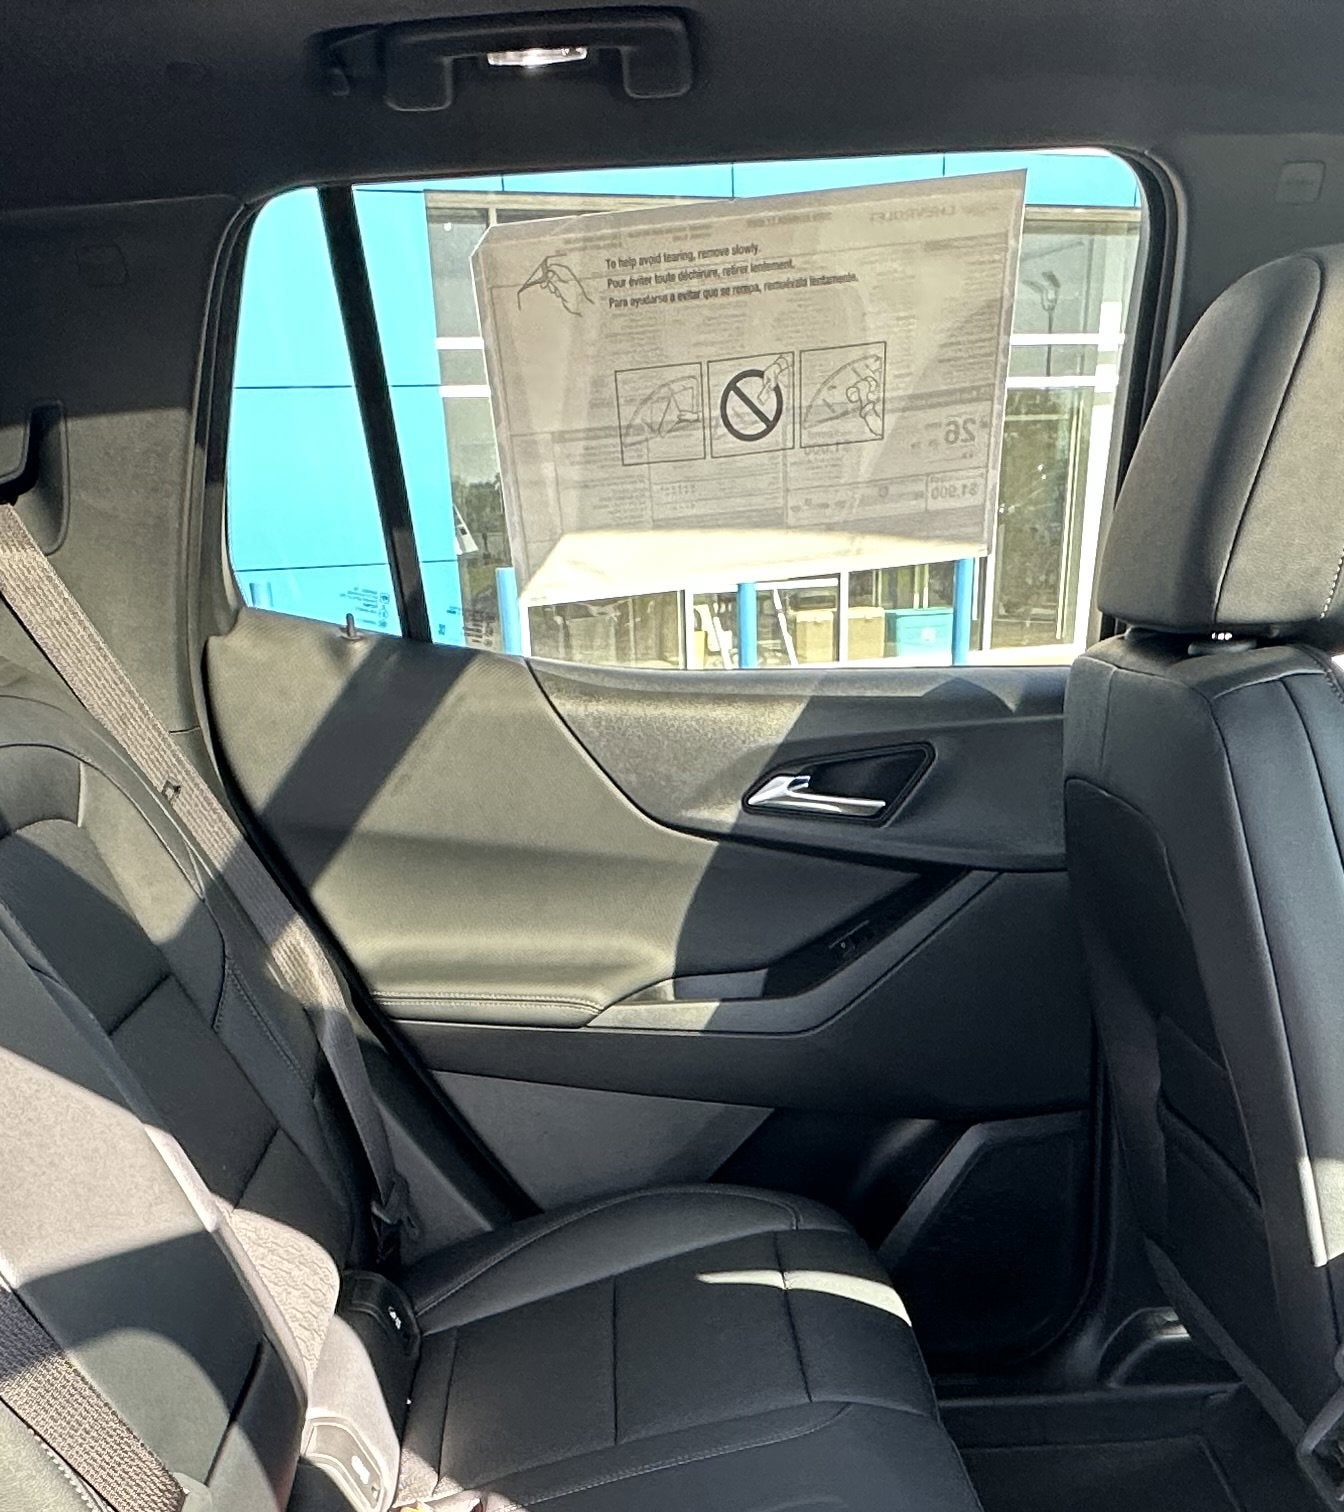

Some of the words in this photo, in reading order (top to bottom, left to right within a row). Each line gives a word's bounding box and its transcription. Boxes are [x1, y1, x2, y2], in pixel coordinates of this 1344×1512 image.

[605, 259, 616, 270] To
[618, 257, 636, 270] help
[639, 252, 661, 266] avoid
[663, 251, 696, 263] tearing,
[698, 247, 730, 259] remove
[607, 278, 626, 288] Pour
[629, 275, 652, 287] éviter
[655, 272, 676, 284] toute
[723, 264, 749, 276] retirer
[609, 297, 628, 309] Para
[677, 290, 700, 301] evitar
[703, 288, 718, 300] que
[720, 287, 730, 296] se
